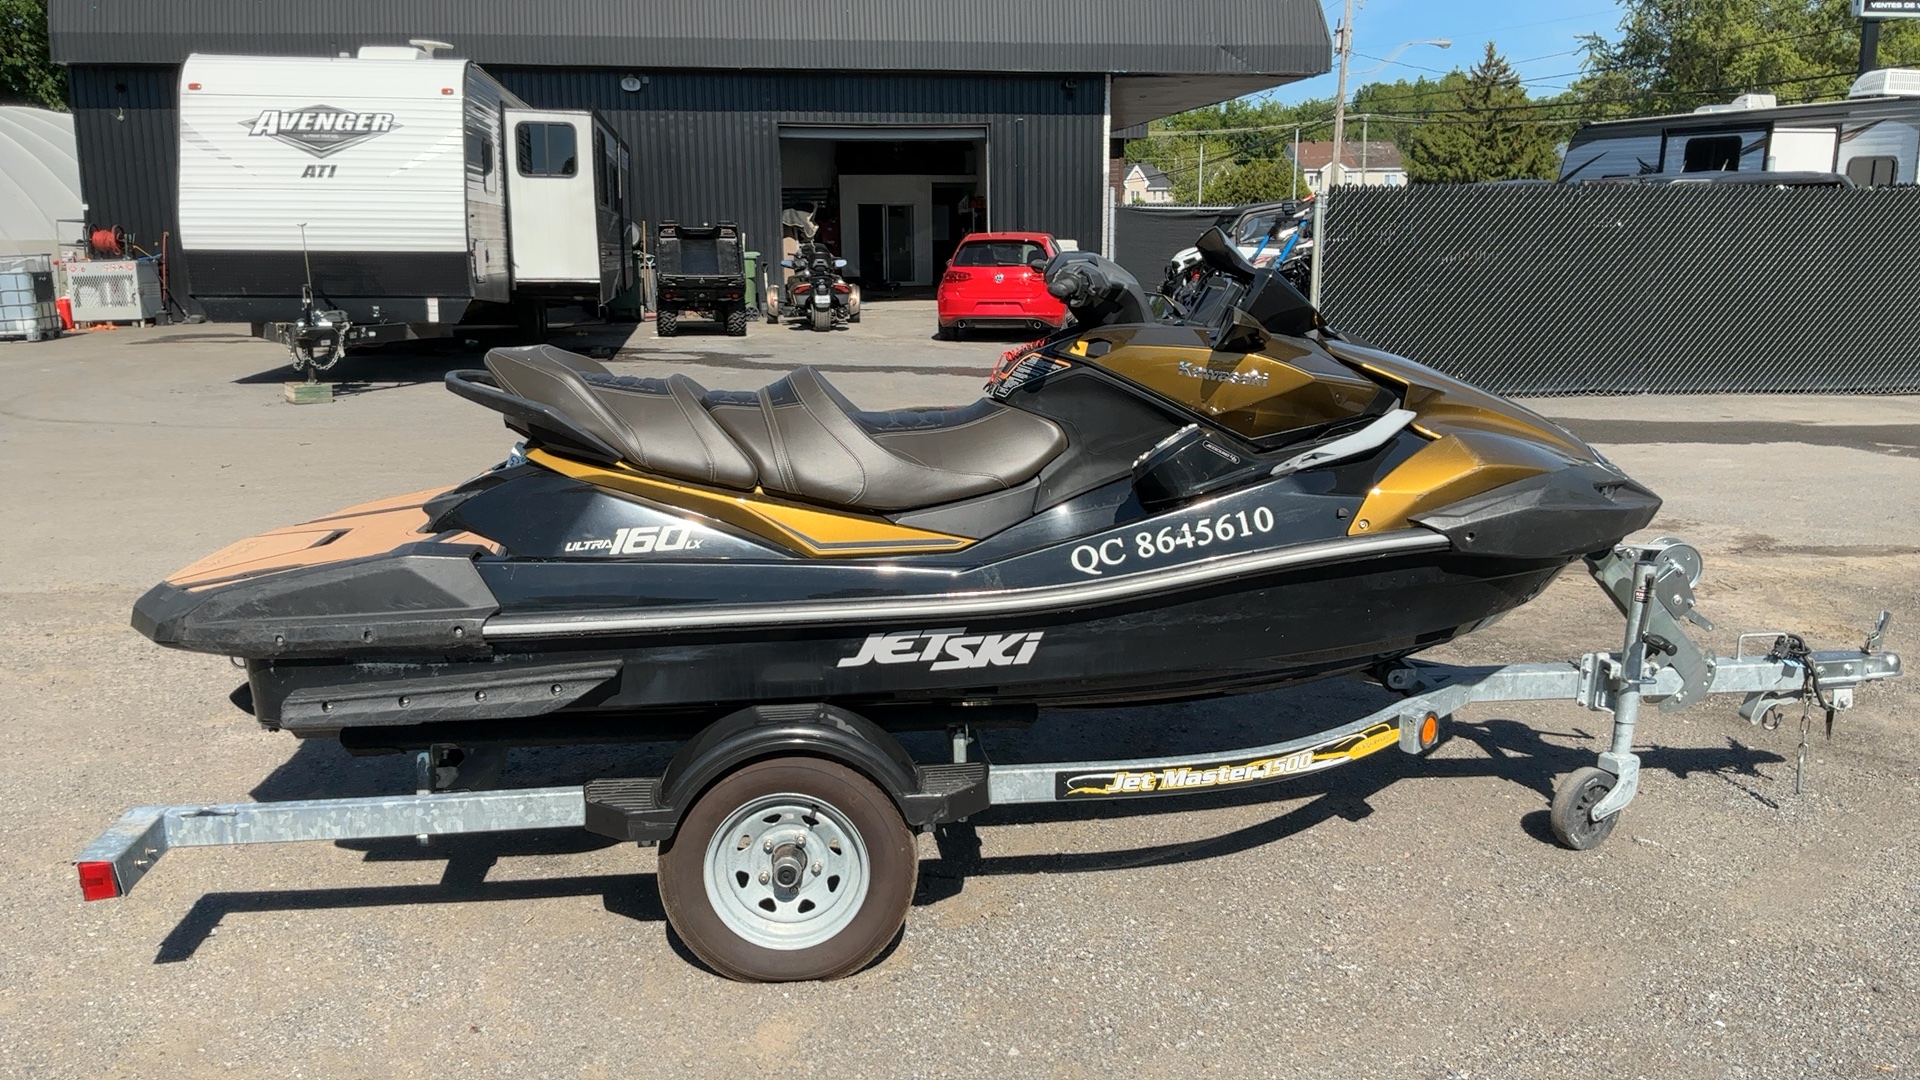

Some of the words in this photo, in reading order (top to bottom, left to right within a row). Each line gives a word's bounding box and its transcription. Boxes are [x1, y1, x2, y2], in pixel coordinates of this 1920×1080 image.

[249, 110, 394, 136] AVENGER
[301, 165, 338, 178] ATI
[1178, 361, 1269, 387] Kawasaki
[565, 539, 612, 552] ULTRA
[609, 526, 692, 555] 160
[1070, 537, 1127, 574] QC
[1135, 506, 1275, 558] 8645610
[1105, 771, 1157, 792] Jet
[1158, 764, 1256, 790] Master
[1262, 750, 1315, 778] 1500
